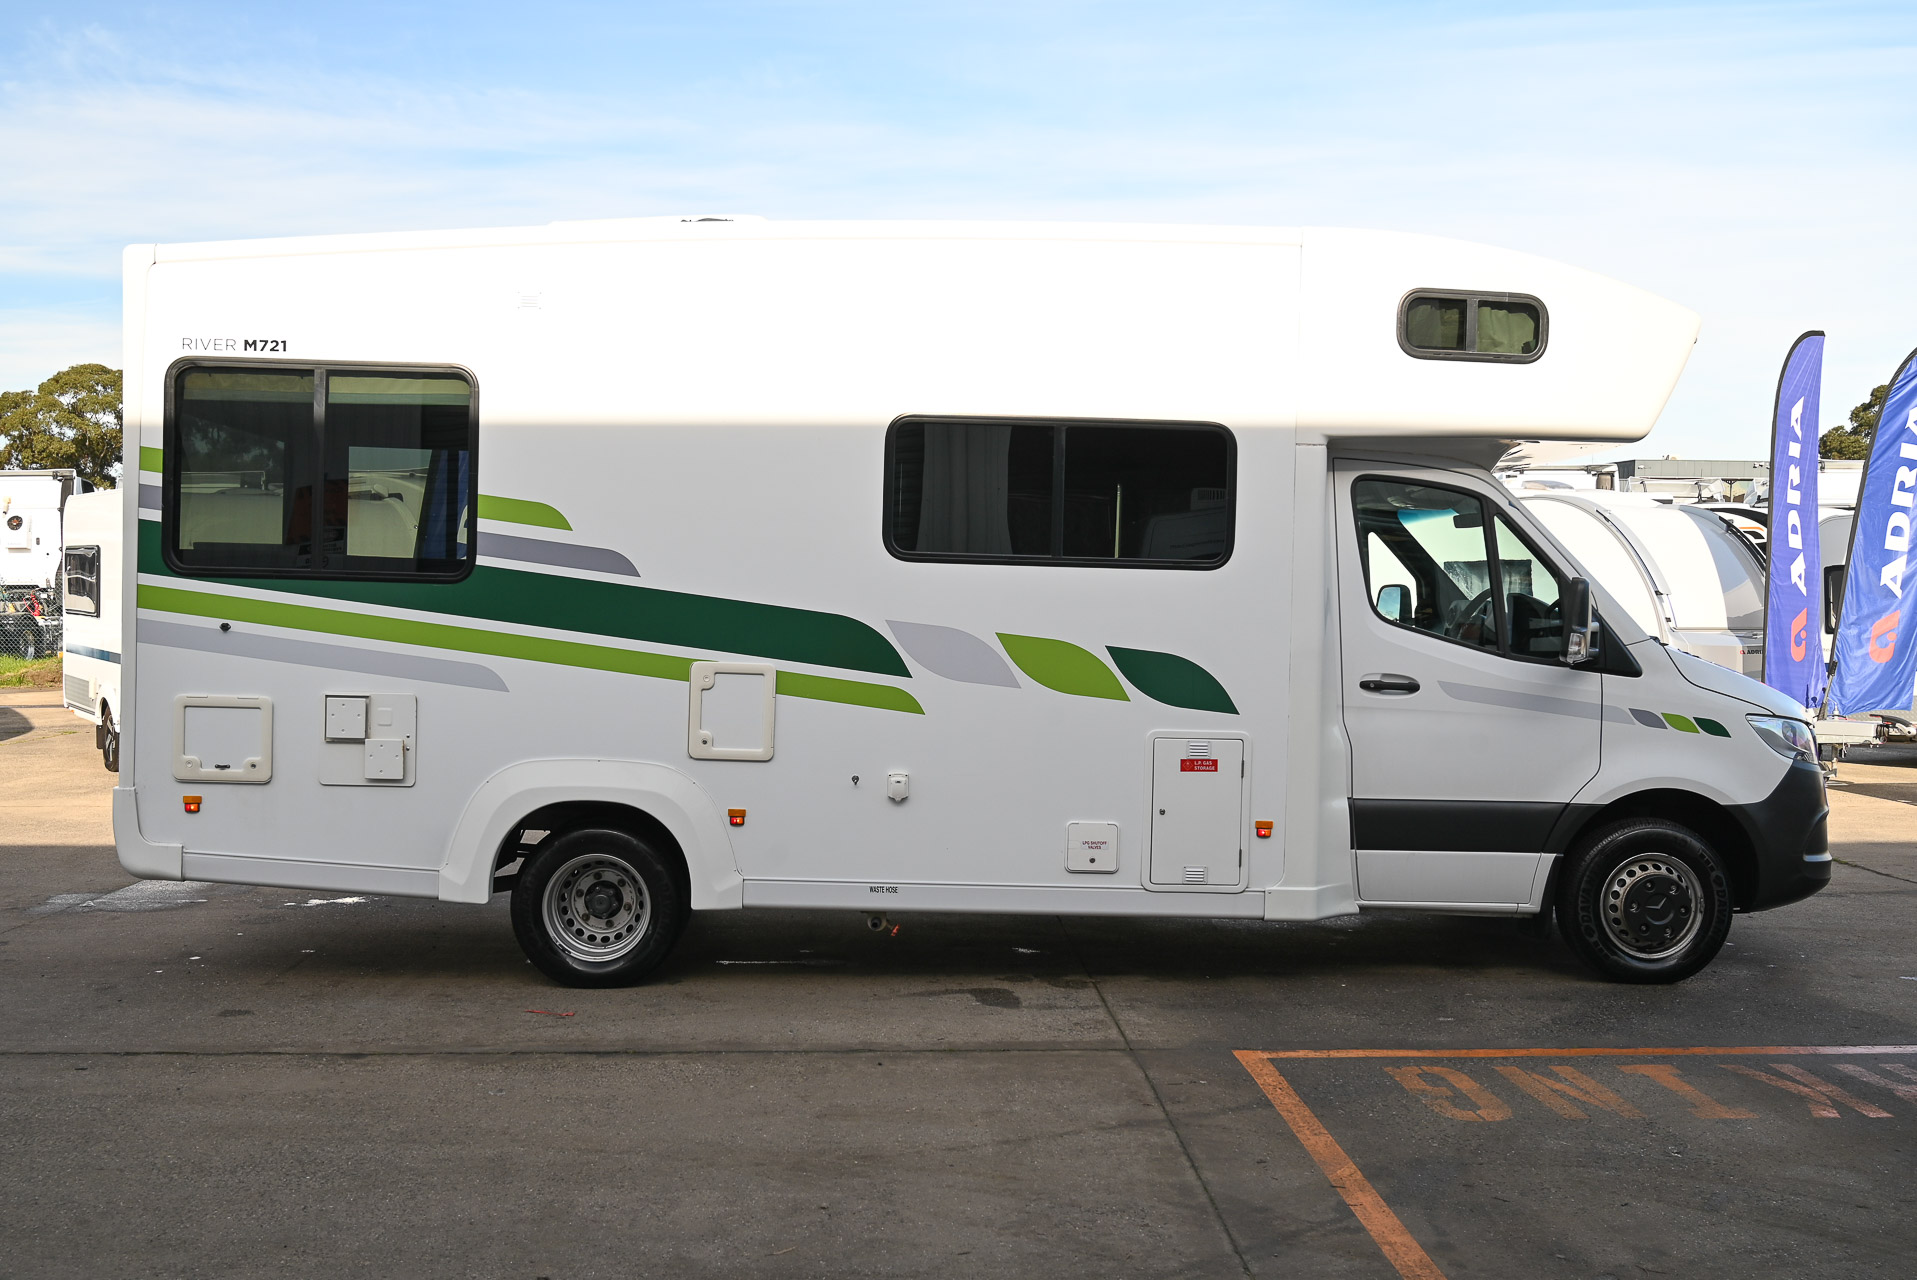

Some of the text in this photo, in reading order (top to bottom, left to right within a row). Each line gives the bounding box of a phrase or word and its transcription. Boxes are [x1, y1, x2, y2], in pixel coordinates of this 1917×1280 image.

[182, 337, 287, 352] RIVER M721
[1787, 395, 1807, 597] ADRIA
[869, 886, 898, 894] WASTE HOSE
